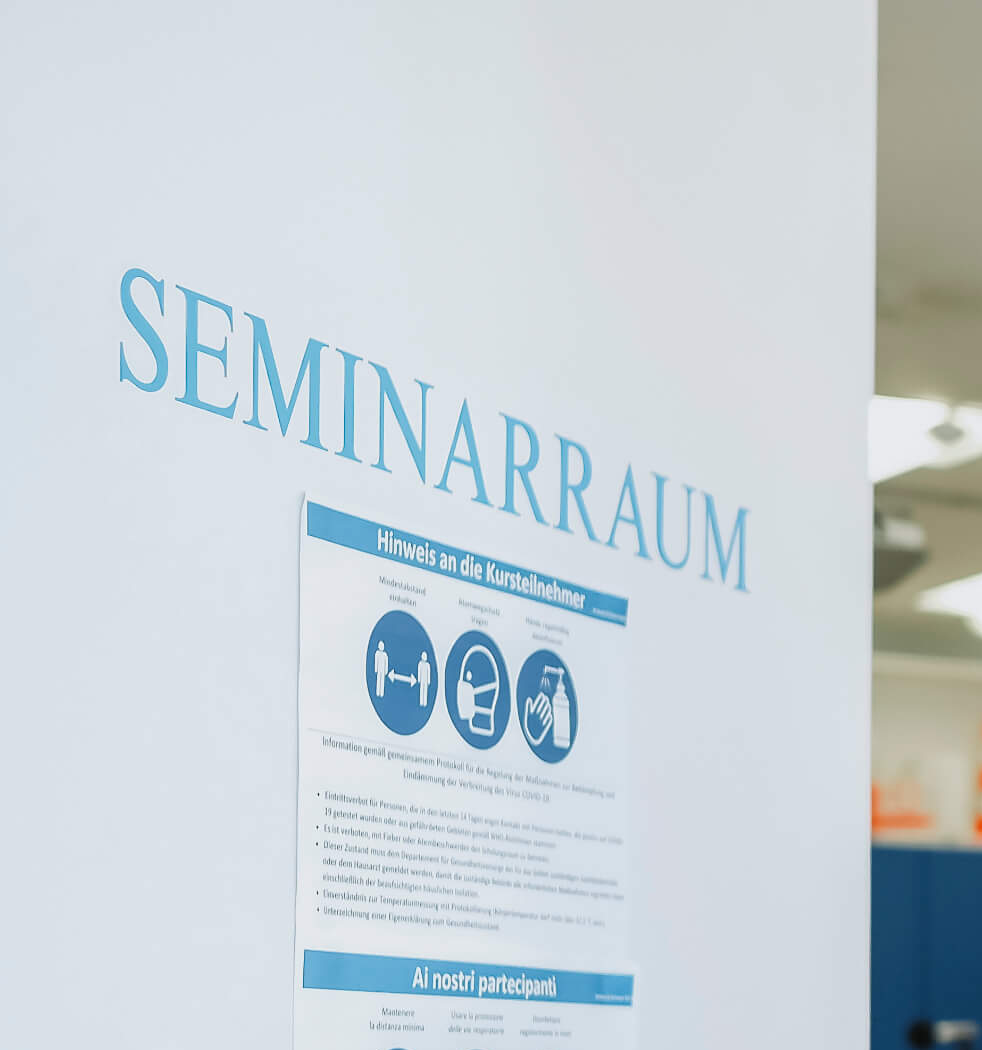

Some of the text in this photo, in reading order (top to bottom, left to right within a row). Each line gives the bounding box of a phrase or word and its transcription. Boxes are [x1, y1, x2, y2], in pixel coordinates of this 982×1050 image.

[119, 267, 751, 594] SEMINARRAUM
[377, 528, 437, 567] Hinweis
[440, 552, 457, 573] an
[461, 554, 483, 580] die
[486, 560, 586, 609] Kursteilnehmer
[322, 735, 362, 753] Information
[412, 966, 557, 1000] Ai nostri partecipanti
